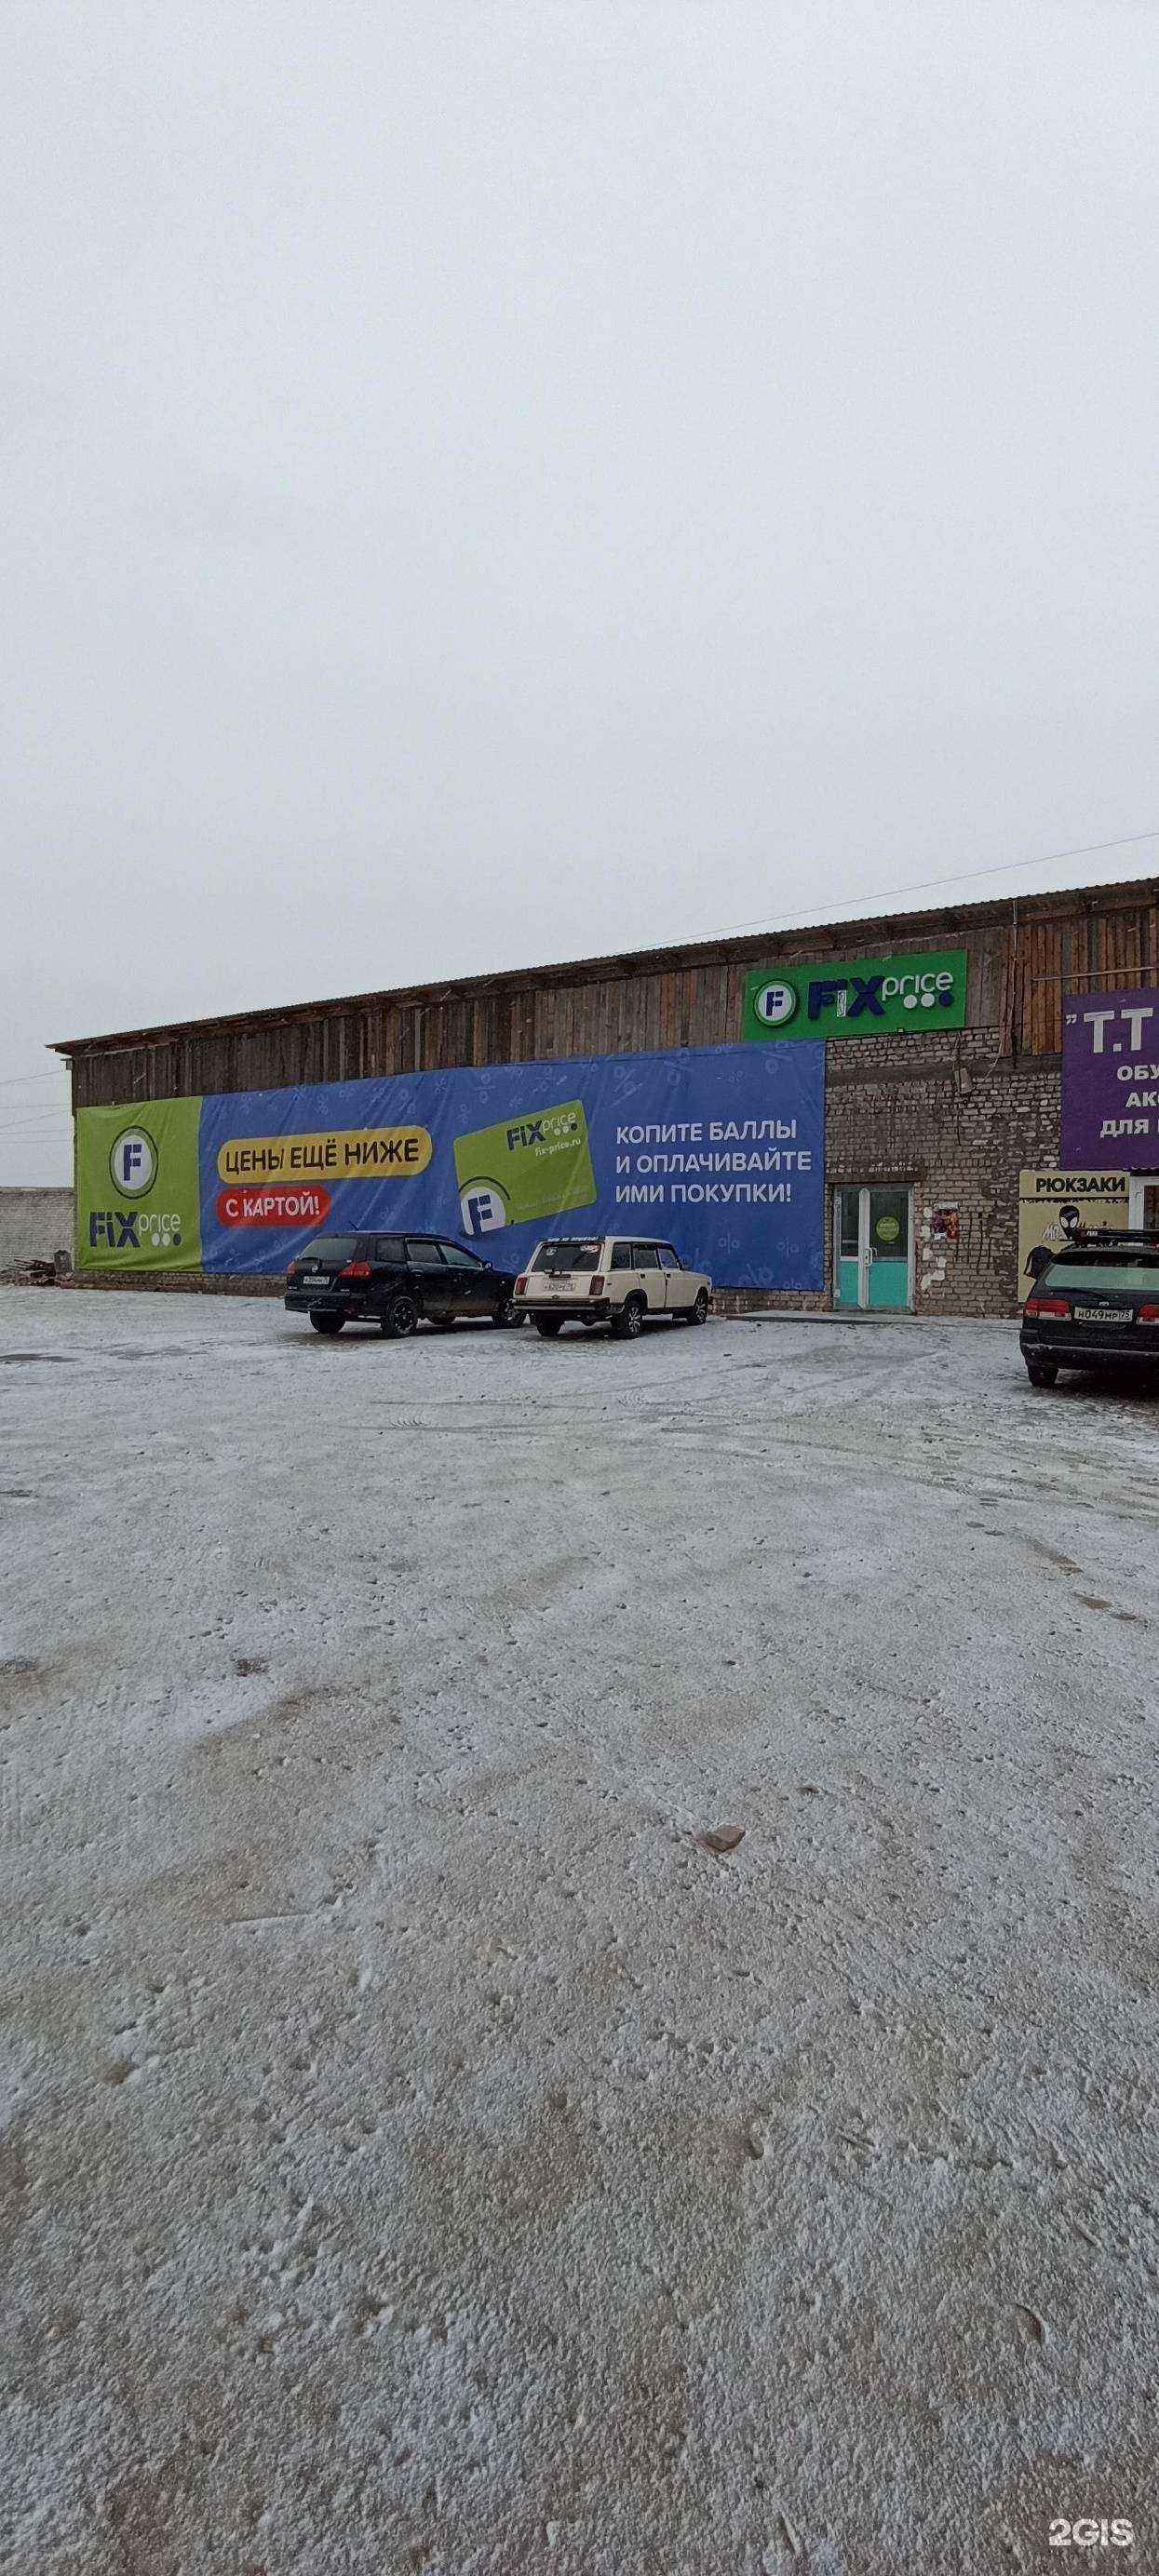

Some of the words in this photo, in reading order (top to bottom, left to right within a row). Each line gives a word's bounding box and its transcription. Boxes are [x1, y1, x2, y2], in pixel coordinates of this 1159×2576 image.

[882, 972, 953, 1000] price
[615, 1122, 703, 1145] КОПИТЕ
[709, 1119, 797, 1141] БАЛЛЫ
[1099, 1119, 1149, 1138] ДЛЯ
[225, 1147, 284, 1174] ЦЕНЫ
[290, 1138, 337, 1171] ЕЩЁ
[344, 1137, 419, 1165] НИЖЕ
[615, 1155, 630, 1174] И
[637, 1147, 812, 1173] ОПЛАЧИВАЙТЕ
[615, 1185, 664, 1203] ИМИ
[670, 1183, 791, 1203] ПОКУПКИ!
[1035, 1176, 1125, 1192] РЮКЗАКИ
[225, 1200, 238, 1217] С
[243, 1191, 320, 1217] КАРТОЙ!
[138, 1214, 181, 1236] price
